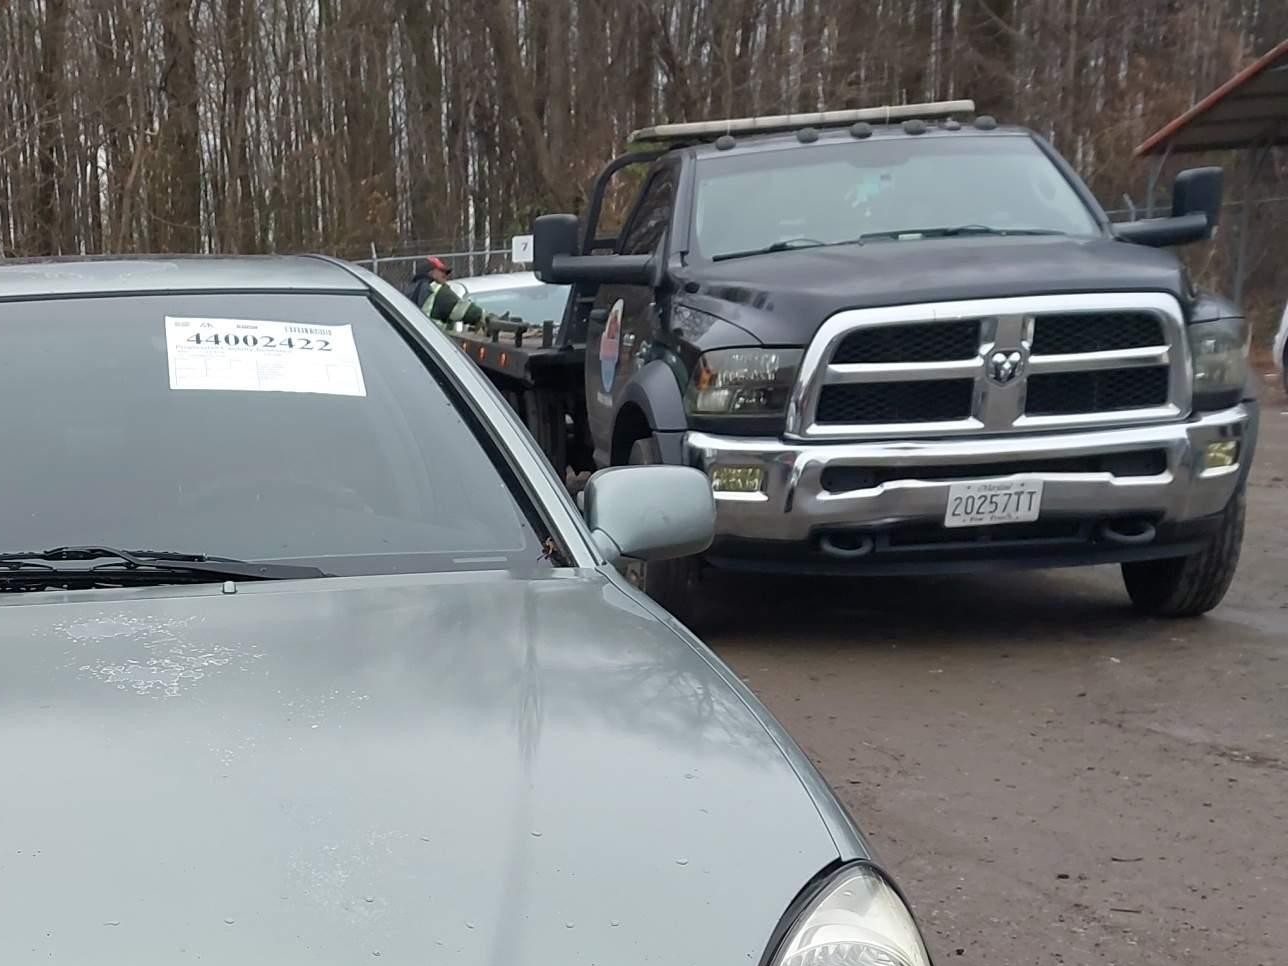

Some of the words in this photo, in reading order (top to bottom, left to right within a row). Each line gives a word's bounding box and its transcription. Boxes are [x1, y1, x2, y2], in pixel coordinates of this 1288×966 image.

[521, 242, 529, 252] 7
[186, 332, 333, 352] 44002422
[951, 490, 1037, 517] 20257TT
